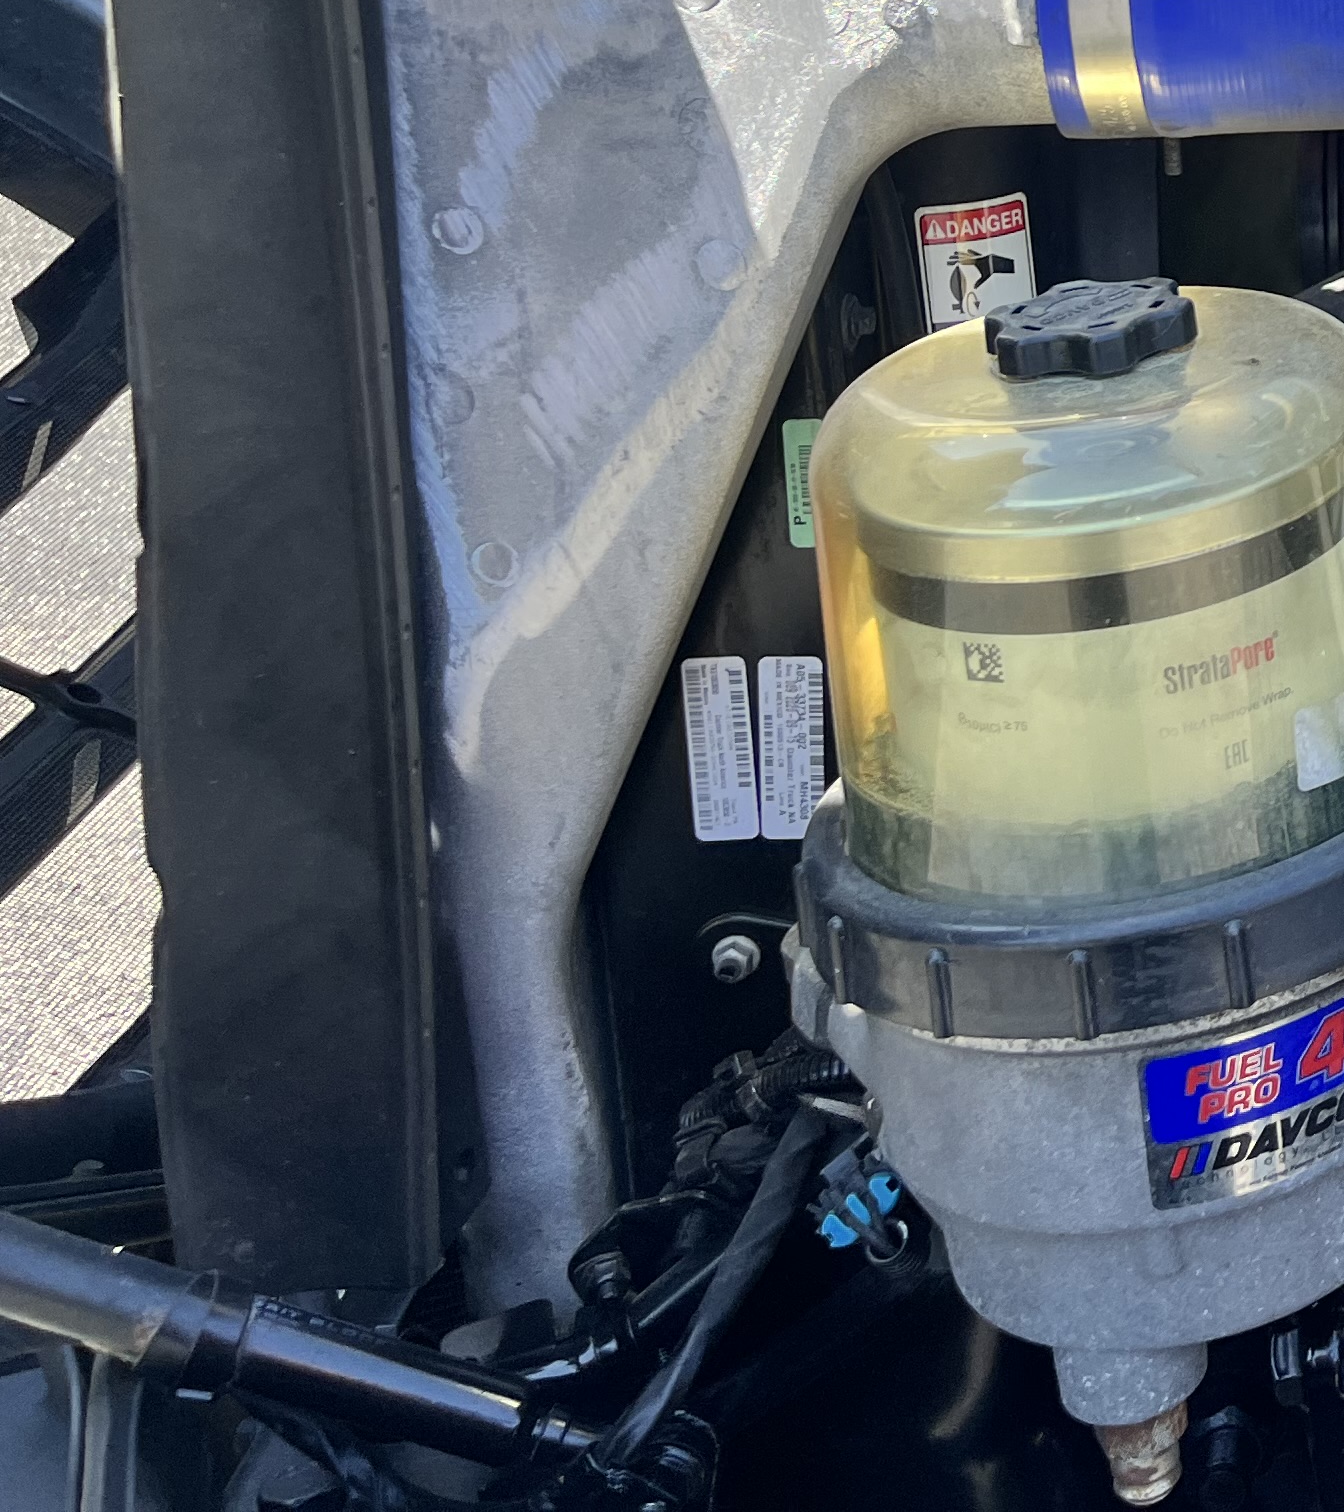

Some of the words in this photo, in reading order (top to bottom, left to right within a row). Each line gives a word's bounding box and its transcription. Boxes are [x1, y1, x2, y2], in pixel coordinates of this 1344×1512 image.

[946, 208, 1024, 238] DANGER
[793, 515, 807, 526] P
[1209, 701, 1260, 726] Remove
[1185, 1042, 1284, 1096] FUEL
[1197, 1074, 1281, 1124] PRO
